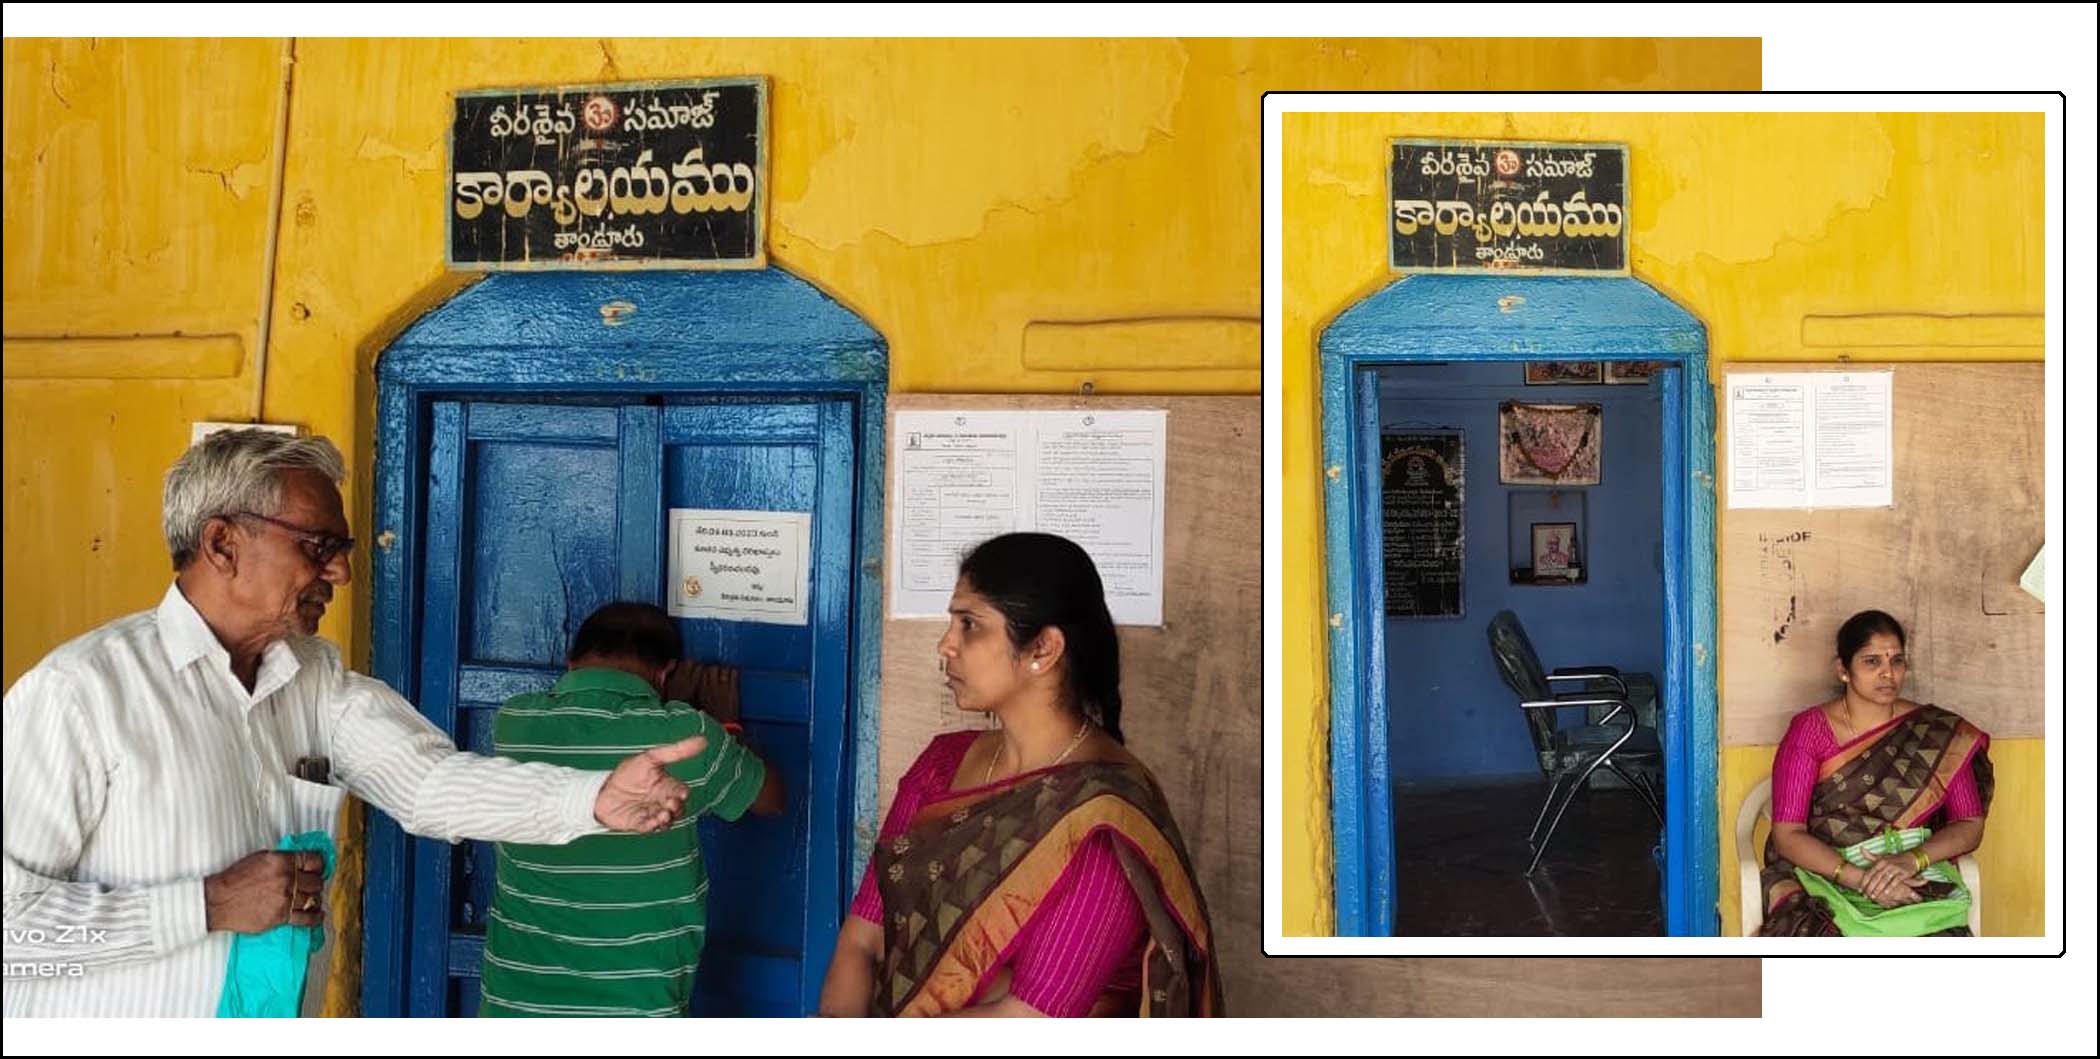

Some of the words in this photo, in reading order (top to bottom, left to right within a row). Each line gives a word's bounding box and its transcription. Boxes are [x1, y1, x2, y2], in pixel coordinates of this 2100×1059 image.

[454, 148, 754, 225] కార్యాలయము
[554, 221, 645, 249] తాండూరు
[1394, 190, 1622, 242] కార్యాలయము
[1475, 240, 1544, 261] తాండూరు
